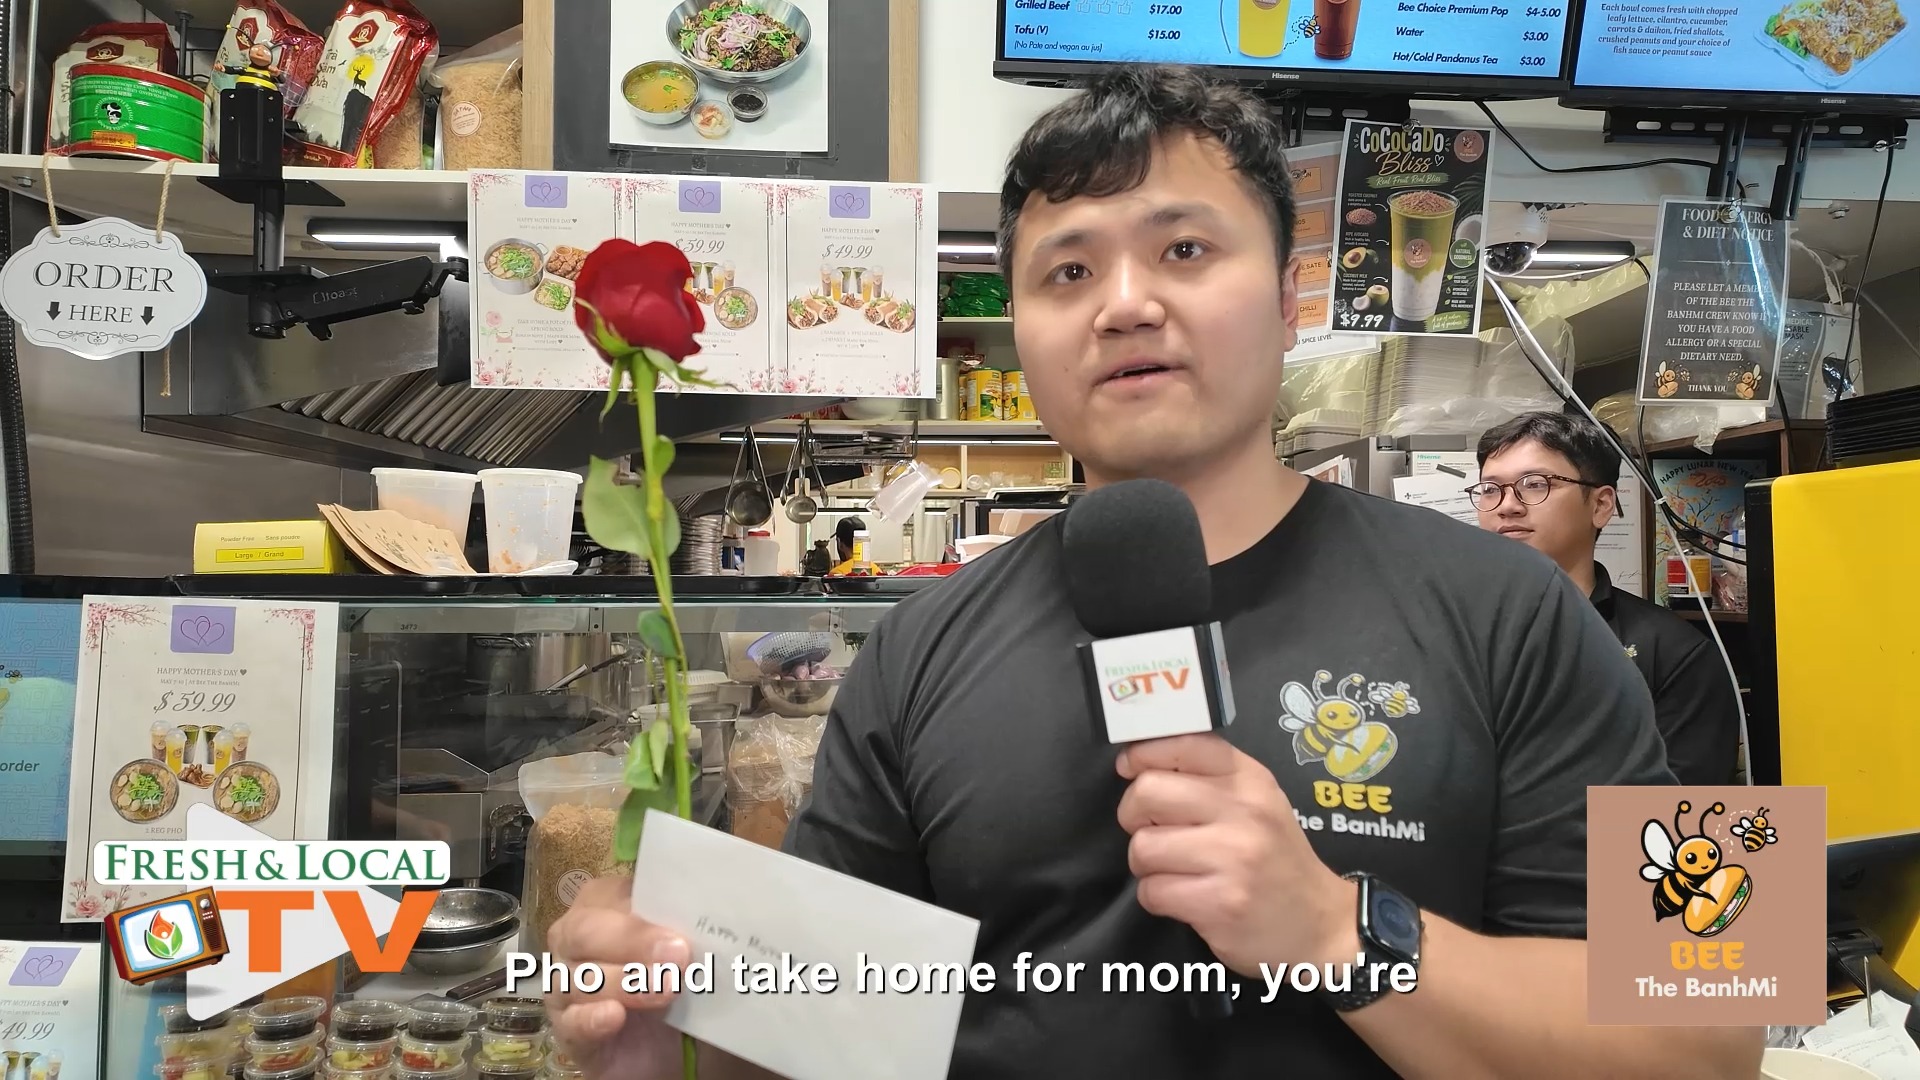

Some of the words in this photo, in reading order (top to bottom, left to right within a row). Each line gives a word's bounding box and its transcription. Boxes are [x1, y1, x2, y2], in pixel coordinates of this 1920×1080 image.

[1015, 0, 1046, 9] Grilled
[1049, 0, 1070, 10] Beef
[1149, 3, 1182, 15] $17.00
[1398, 3, 1415, 12] Bee
[1417, 3, 1446, 13] Choice
[1448, 5, 1488, 15] Premium
[1490, 7, 1508, 17] Pop
[1601, 3, 1620, 11] Each
[1621, 3, 1640, 12] bowl
[1666, 5, 1686, 14] fresh
[1688, 6, 1705, 14] with
[1706, 7, 1738, 17] chopped
[1525, 6, 1561, 18] $4-5.00
[1607, 14, 1626, 24] leafy
[1014, 24, 1036, 35] Tofu
[1036, 25, 1049, 35] (V)
[1147, 29, 1181, 40] $15.00
[1396, 27, 1424, 37] Water
[1607, 25, 1636, 33] carrots
[1637, 25, 1644, 33] &
[1673, 26, 1692, 35] fried
[1523, 31, 1549, 42] $3.00
[1598, 35, 1629, 43] crushed
[1630, 36, 1661, 46] peanuts
[1661, 37, 1677, 45] and
[1678, 39, 1697, 47] your
[1697, 38, 1721, 46] choice
[1722, 38, 1731, 47] of
[1014, 41, 1027, 50] (No
[1028, 42, 1043, 50] Pate
[1044, 42, 1058, 50] and
[1059, 44, 1080, 52] vegan
[1613, 46, 1627, 54] fish
[1628, 47, 1651, 55] sauce
[1662, 48, 1689, 57] peanut
[1690, 49, 1712, 57] sauce
[1393, 52, 1434, 63] Hot/Cold
[1435, 53, 1480, 64] Pandanus
[1482, 55, 1498, 65] Tea
[1519, 56, 1546, 67] $3.00
[1271, 72, 1300, 80] Hisense
[1820, 97, 1847, 105] Hisense
[1375, 150, 1433, 176] Bliss
[1376, 176, 1390, 186] Real
[1411, 174, 1425, 184] Real
[1425, 173, 1441, 183] Bliss
[1682, 208, 1719, 222] FOOD
[1682, 225, 1693, 238] &
[1696, 226, 1730, 239] DIET
[1731, 228, 1774, 242] NOTICE
[33, 261, 175, 293] ORDER
[1673, 282, 1706, 292] PLEASE
[1708, 283, 1724, 292] LET
[1725, 284, 1732, 292] A
[1686, 296, 1698, 306] OF
[1699, 297, 1719, 306] THE
[1719, 298, 1736, 307] BEE
[1737, 298, 1755, 307] THE
[67, 304, 133, 323] HERE
[1667, 310, 1705, 320] BANHMI
[1705, 311, 1730, 320] CREW
[1732, 312, 1760, 321] KNOW
[1340, 311, 1384, 328] $9.99
[1678, 324, 1698, 333] YOU
[1698, 325, 1723, 334] HAVE
[1723, 326, 1730, 334] A
[1731, 326, 1755, 335] FOOD
[1301, 336, 1317, 345] SPICE
[1665, 338, 1706, 347] ALLERGY
[1706, 338, 1719, 347] OR
[1720, 339, 1726, 347] A
[1727, 339, 1762, 348] SPECIAL
[1680, 352, 1717, 361] DIETARY
[1718, 353, 1744, 362] NEED.
[1687, 384, 1713, 393] THANK
[1713, 385, 1728, 393] YOU
[1660, 466, 1685, 484] HAPPY
[1686, 460, 1715, 471] LUNAR
[1717, 461, 1737, 472] NEW
[280, 534, 301, 542] poudre
[235, 552, 254, 560] Large
[157, 667, 182, 675] HAPPY
[223, 669, 239, 677] DAY
[1128, 667, 1189, 694] TV
[0, 759, 41, 772] order
[1312, 780, 1393, 813] BEE
[1292, 808, 1324, 831] he
[1331, 812, 1425, 842] BanhMi
